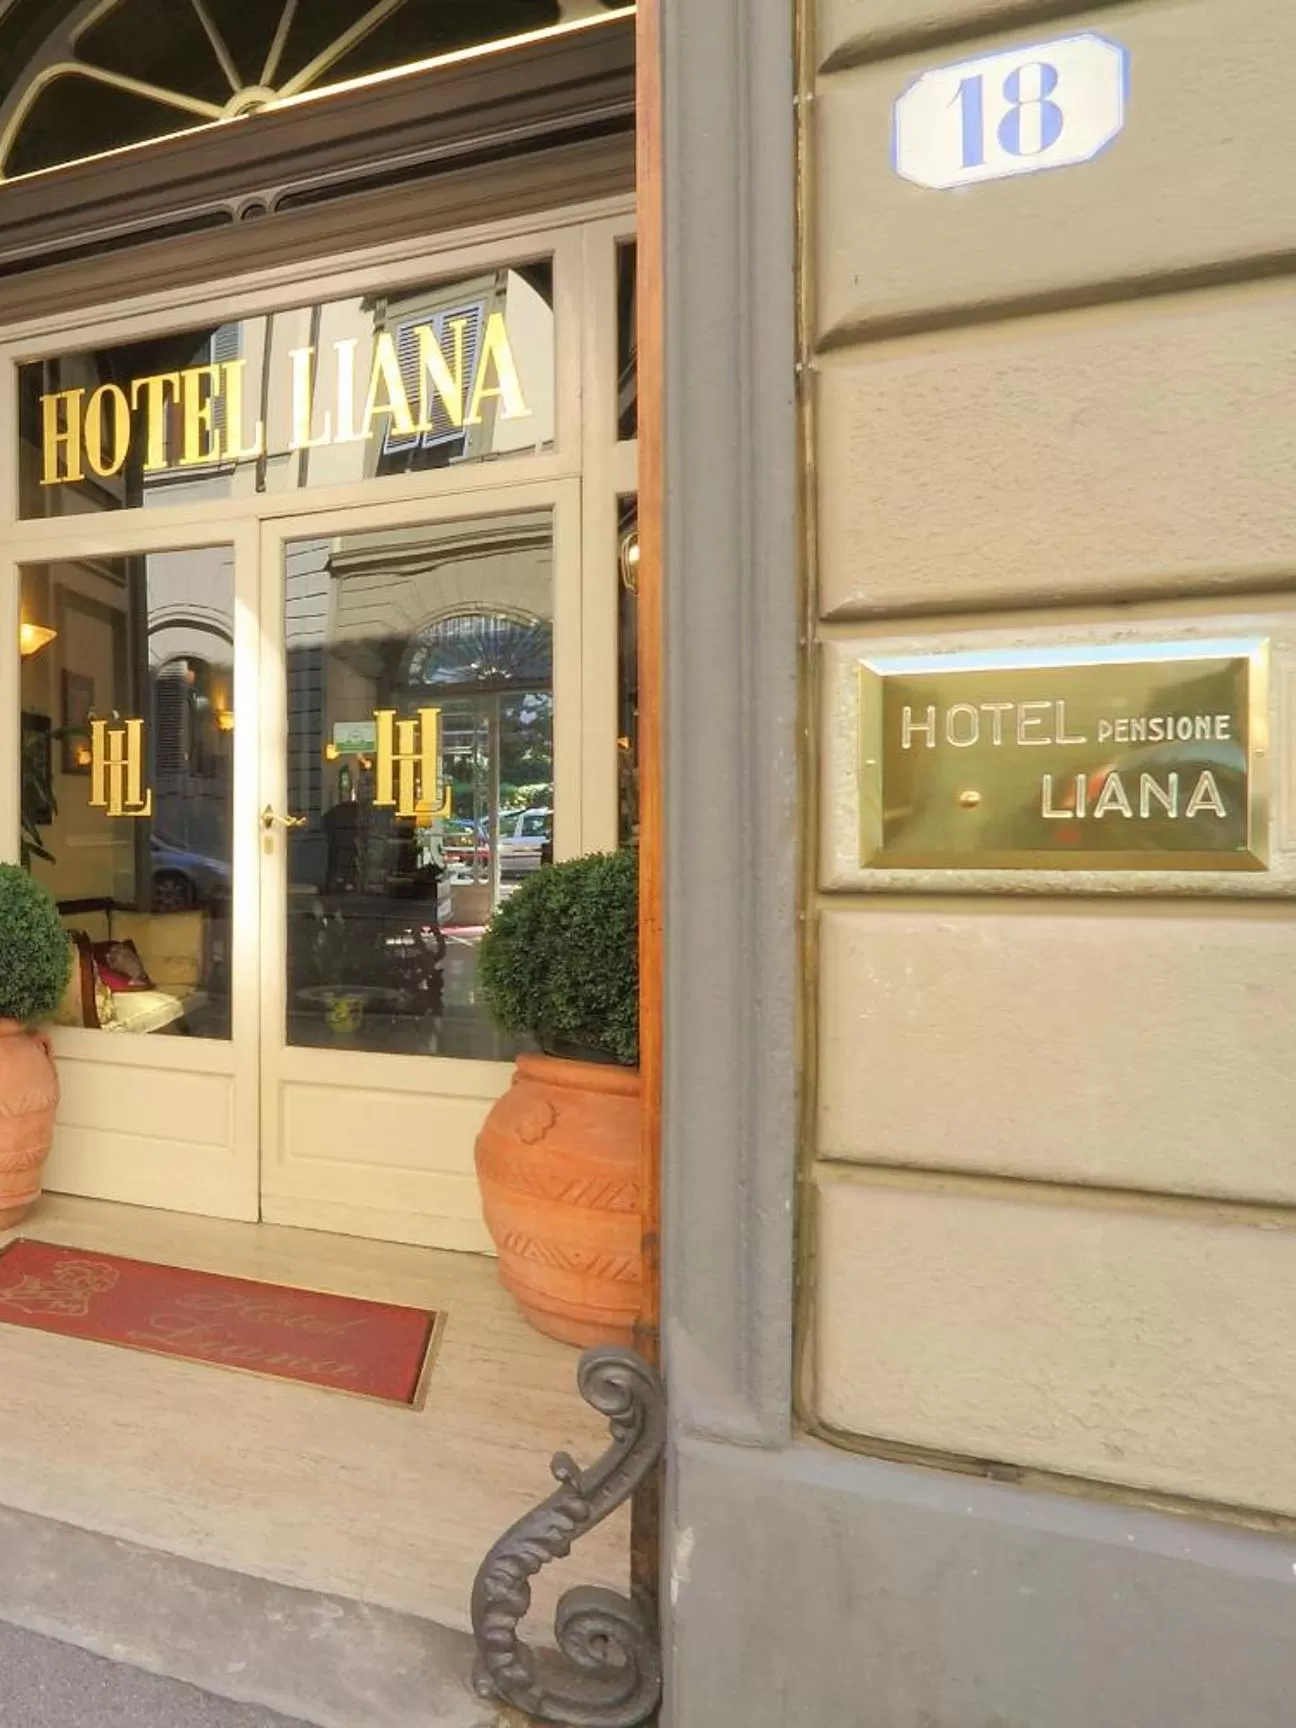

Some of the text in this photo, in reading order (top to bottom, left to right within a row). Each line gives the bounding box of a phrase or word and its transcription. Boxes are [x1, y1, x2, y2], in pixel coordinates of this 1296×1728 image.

[945, 61, 1064, 169] 18
[38, 311, 533, 486] HOTEL LIANA
[901, 701, 1231, 749] HOTEL PENSIONE
[1041, 770, 1228, 819] LIANA
